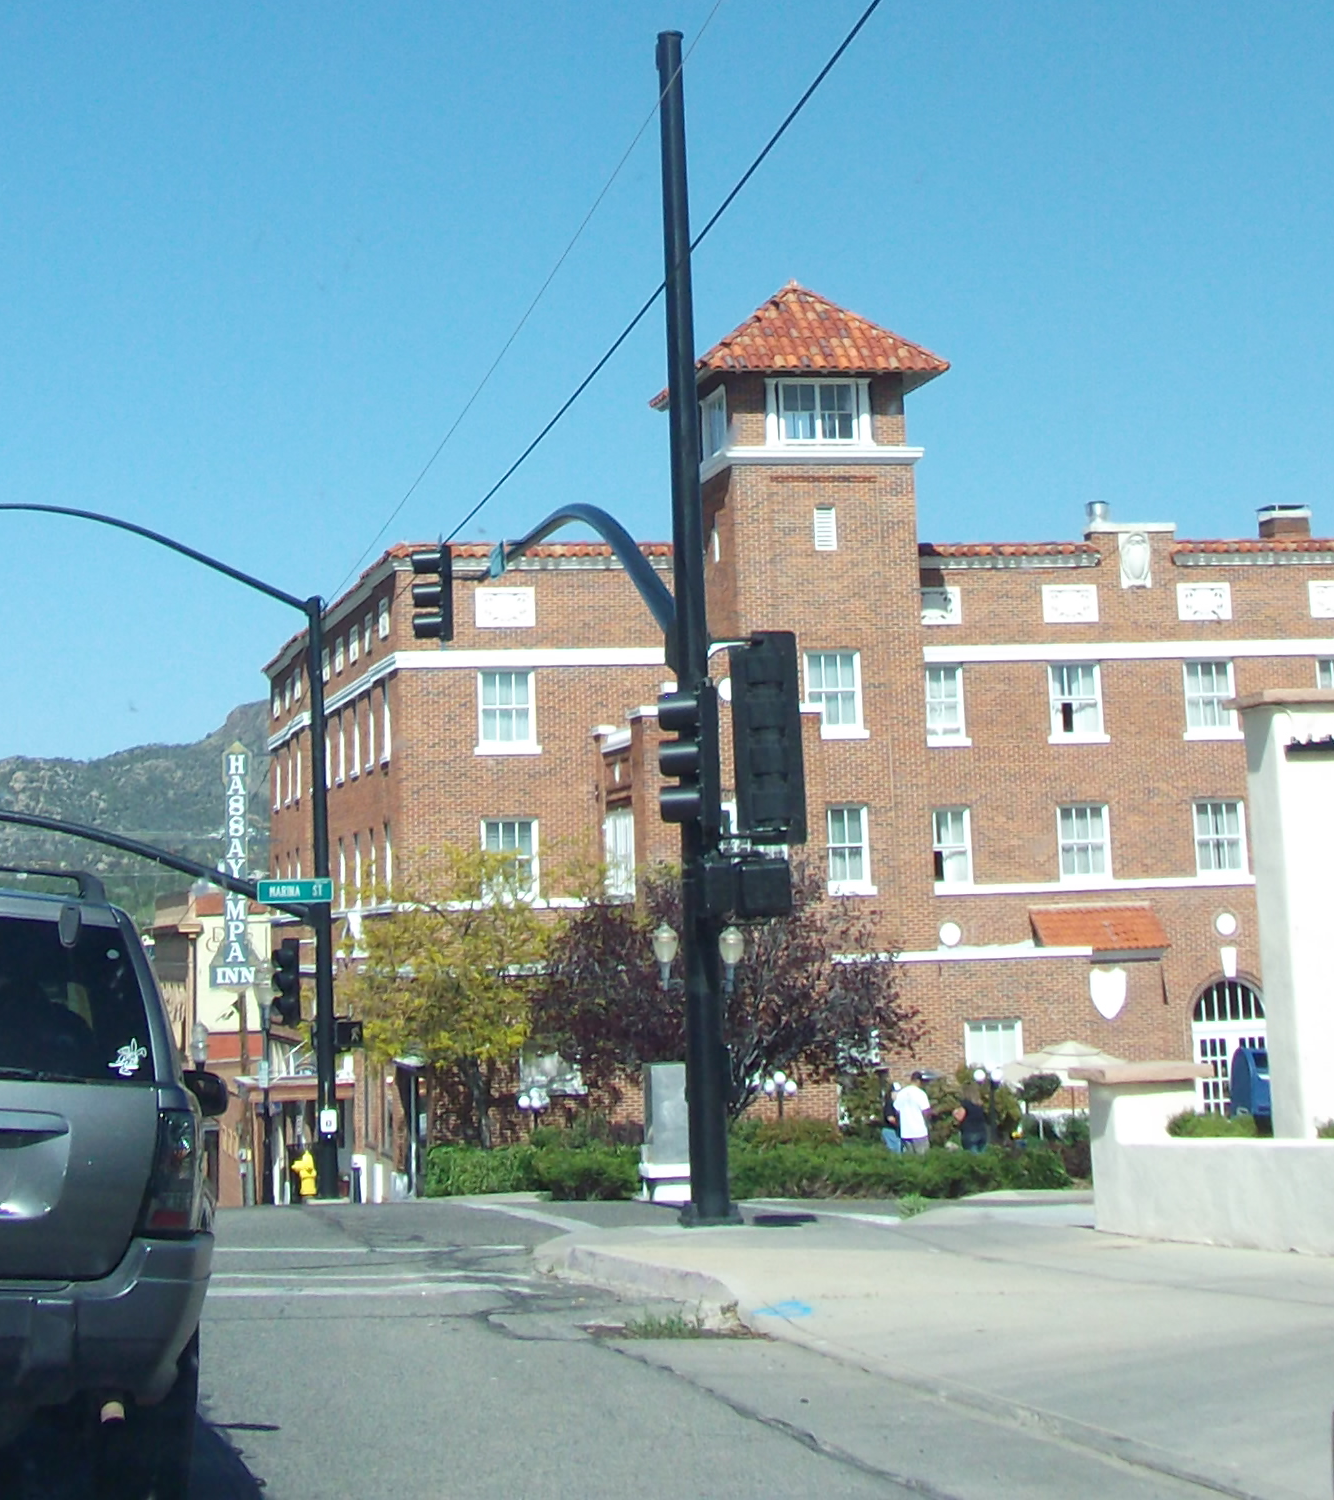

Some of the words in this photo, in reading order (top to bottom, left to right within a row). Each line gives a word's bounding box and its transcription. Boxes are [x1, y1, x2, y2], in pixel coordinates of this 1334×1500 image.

[225, 753, 246, 963] HASSAYMPA
[269, 884, 301, 898] MARINA
[312, 884, 323, 896] ST
[216, 966, 256, 985] INN
